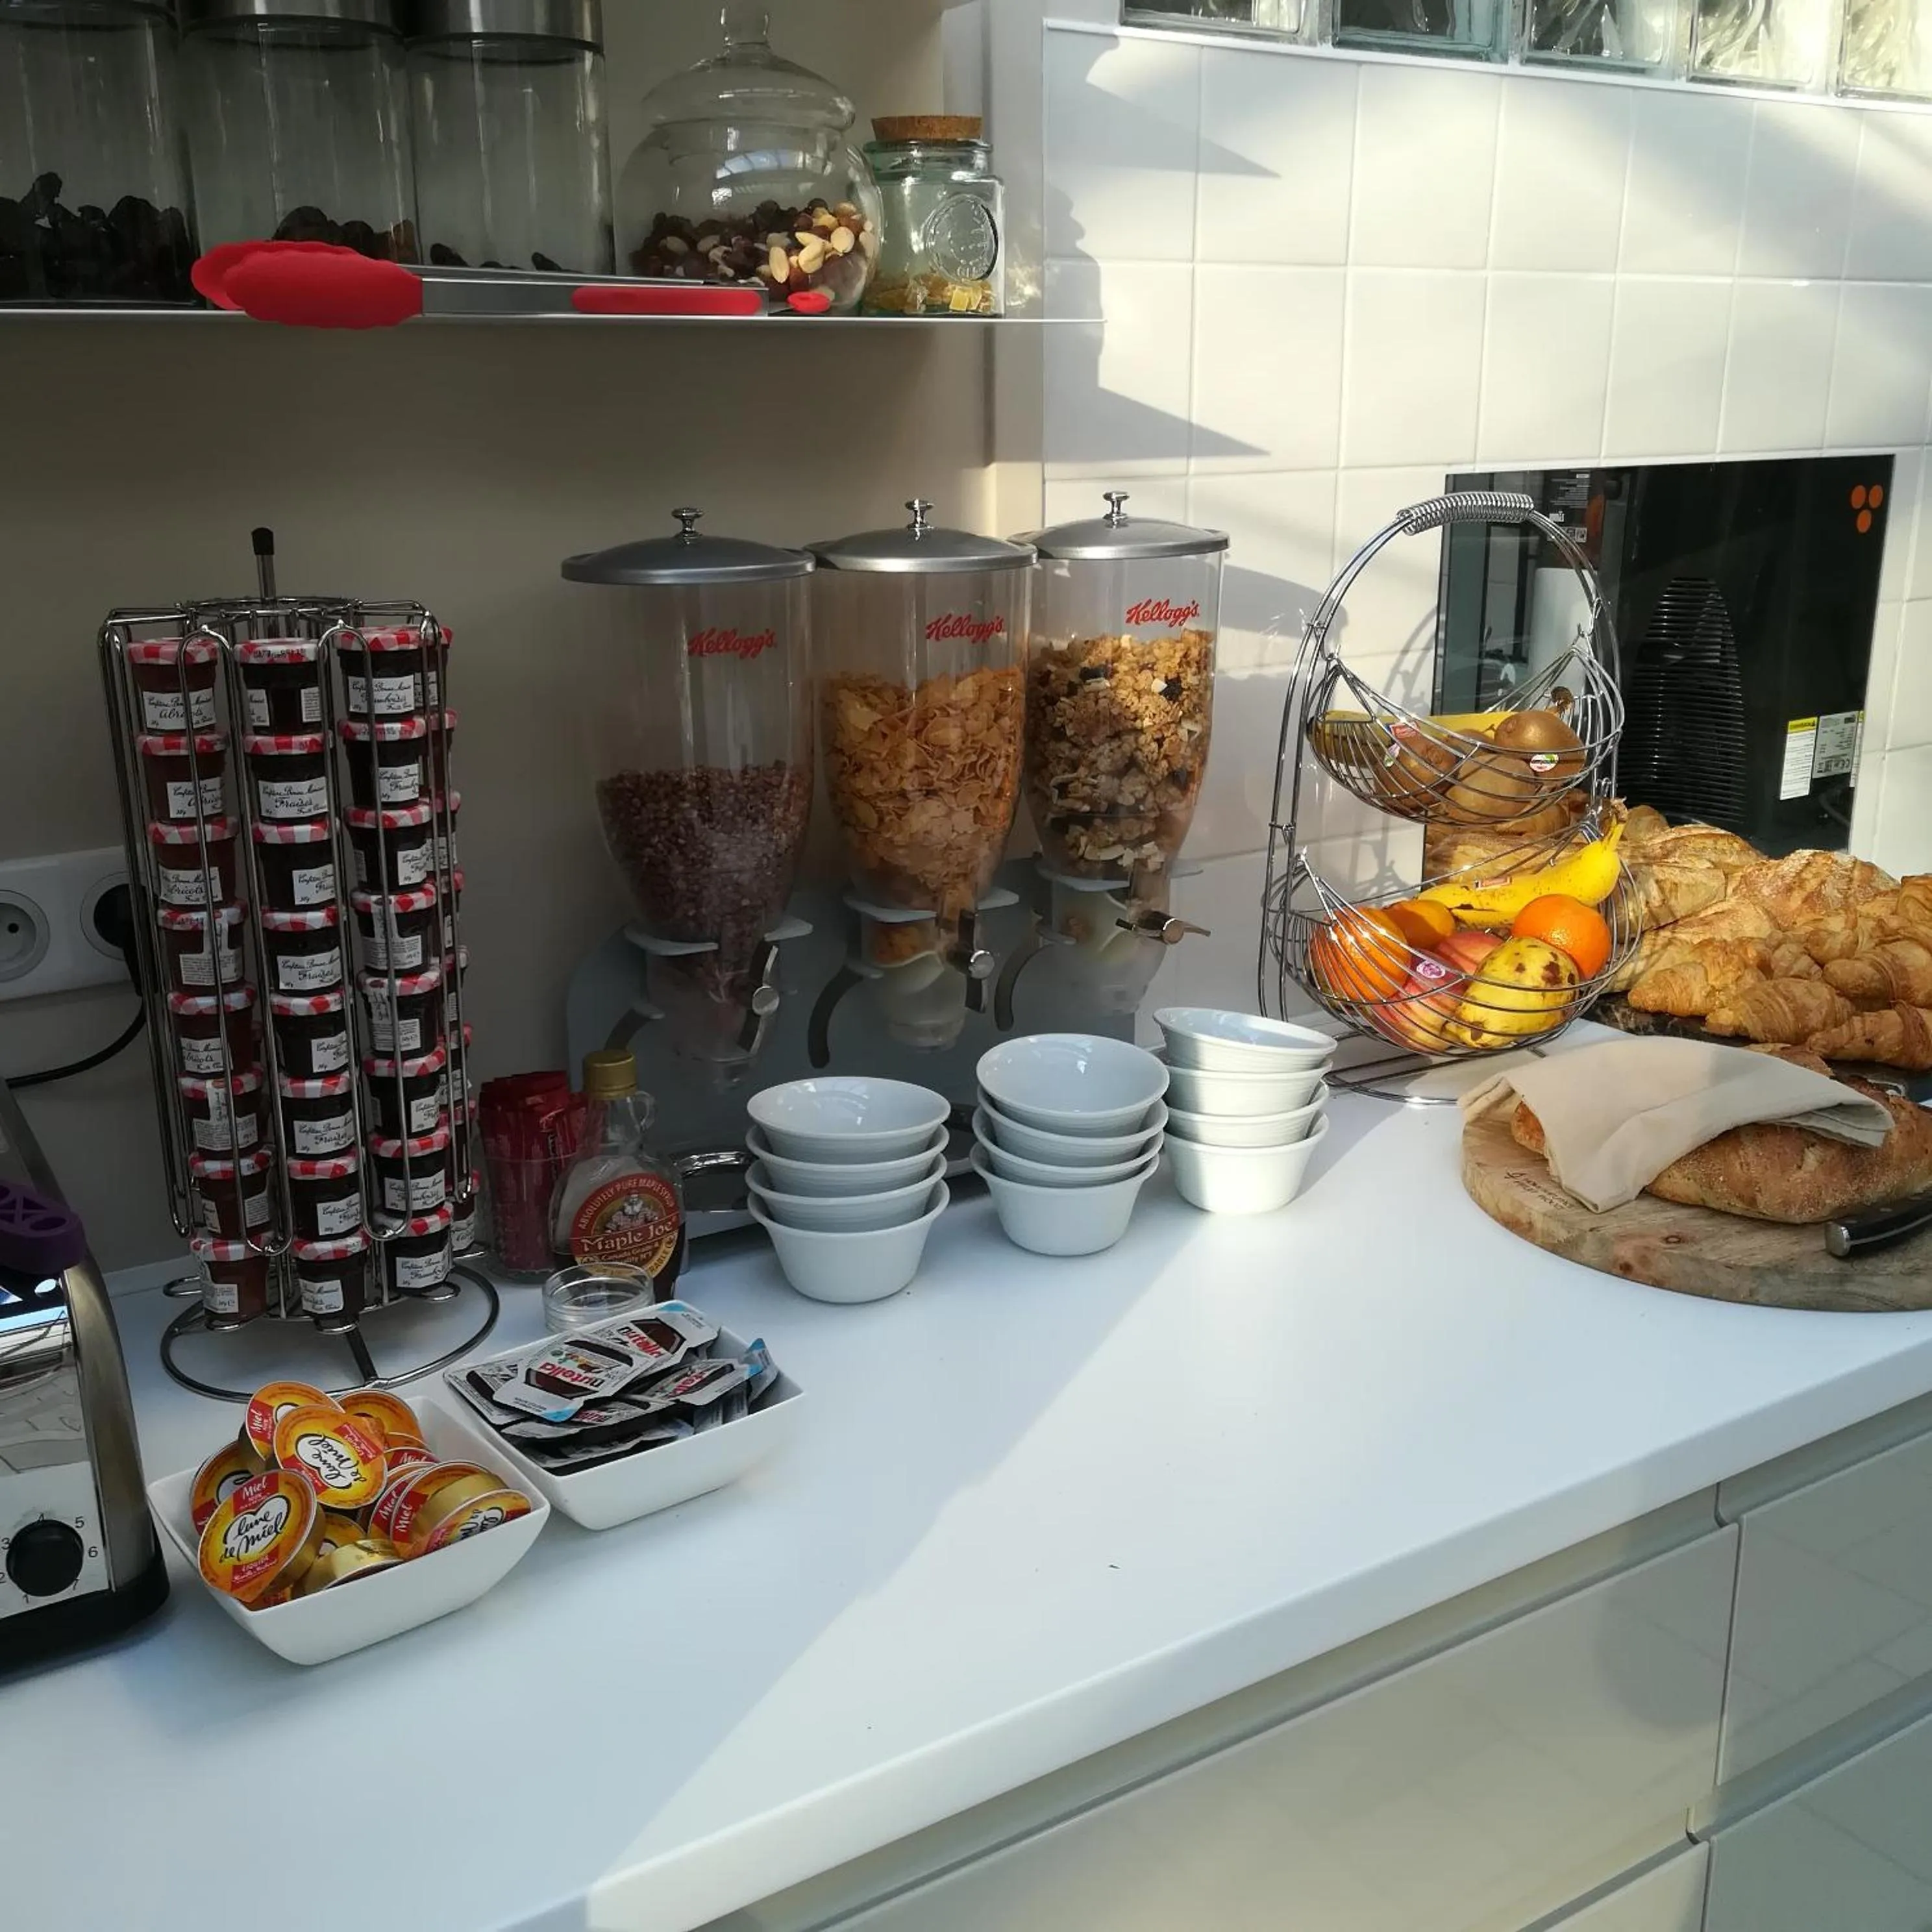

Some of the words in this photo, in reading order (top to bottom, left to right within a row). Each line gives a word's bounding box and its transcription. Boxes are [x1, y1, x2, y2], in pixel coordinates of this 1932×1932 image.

[1125, 598, 1199, 627] Kellogg's
[925, 614, 1004, 643] Kellogg's
[688, 627, 777, 660] Kellogg's
[578, 1187, 615, 1230] ABSOLUTELY
[616, 1178, 638, 1191] PURE
[580, 1231, 644, 1252] Maple
[648, 1221, 673, 1240] Joe
[617, 1326, 664, 1358] nutella
[538, 1362, 606, 1388] nutella
[251, 1408, 263, 1433] Miel
[243, 1476, 267, 1499] Miel
[351, 1468, 367, 1483] de
[75, 1516, 85, 1529] 5
[395, 1503, 413, 1532] Miel
[1, 1537, 11, 1550] 3
[88, 1546, 99, 1558] 6
[219, 1546, 236, 1563] de
